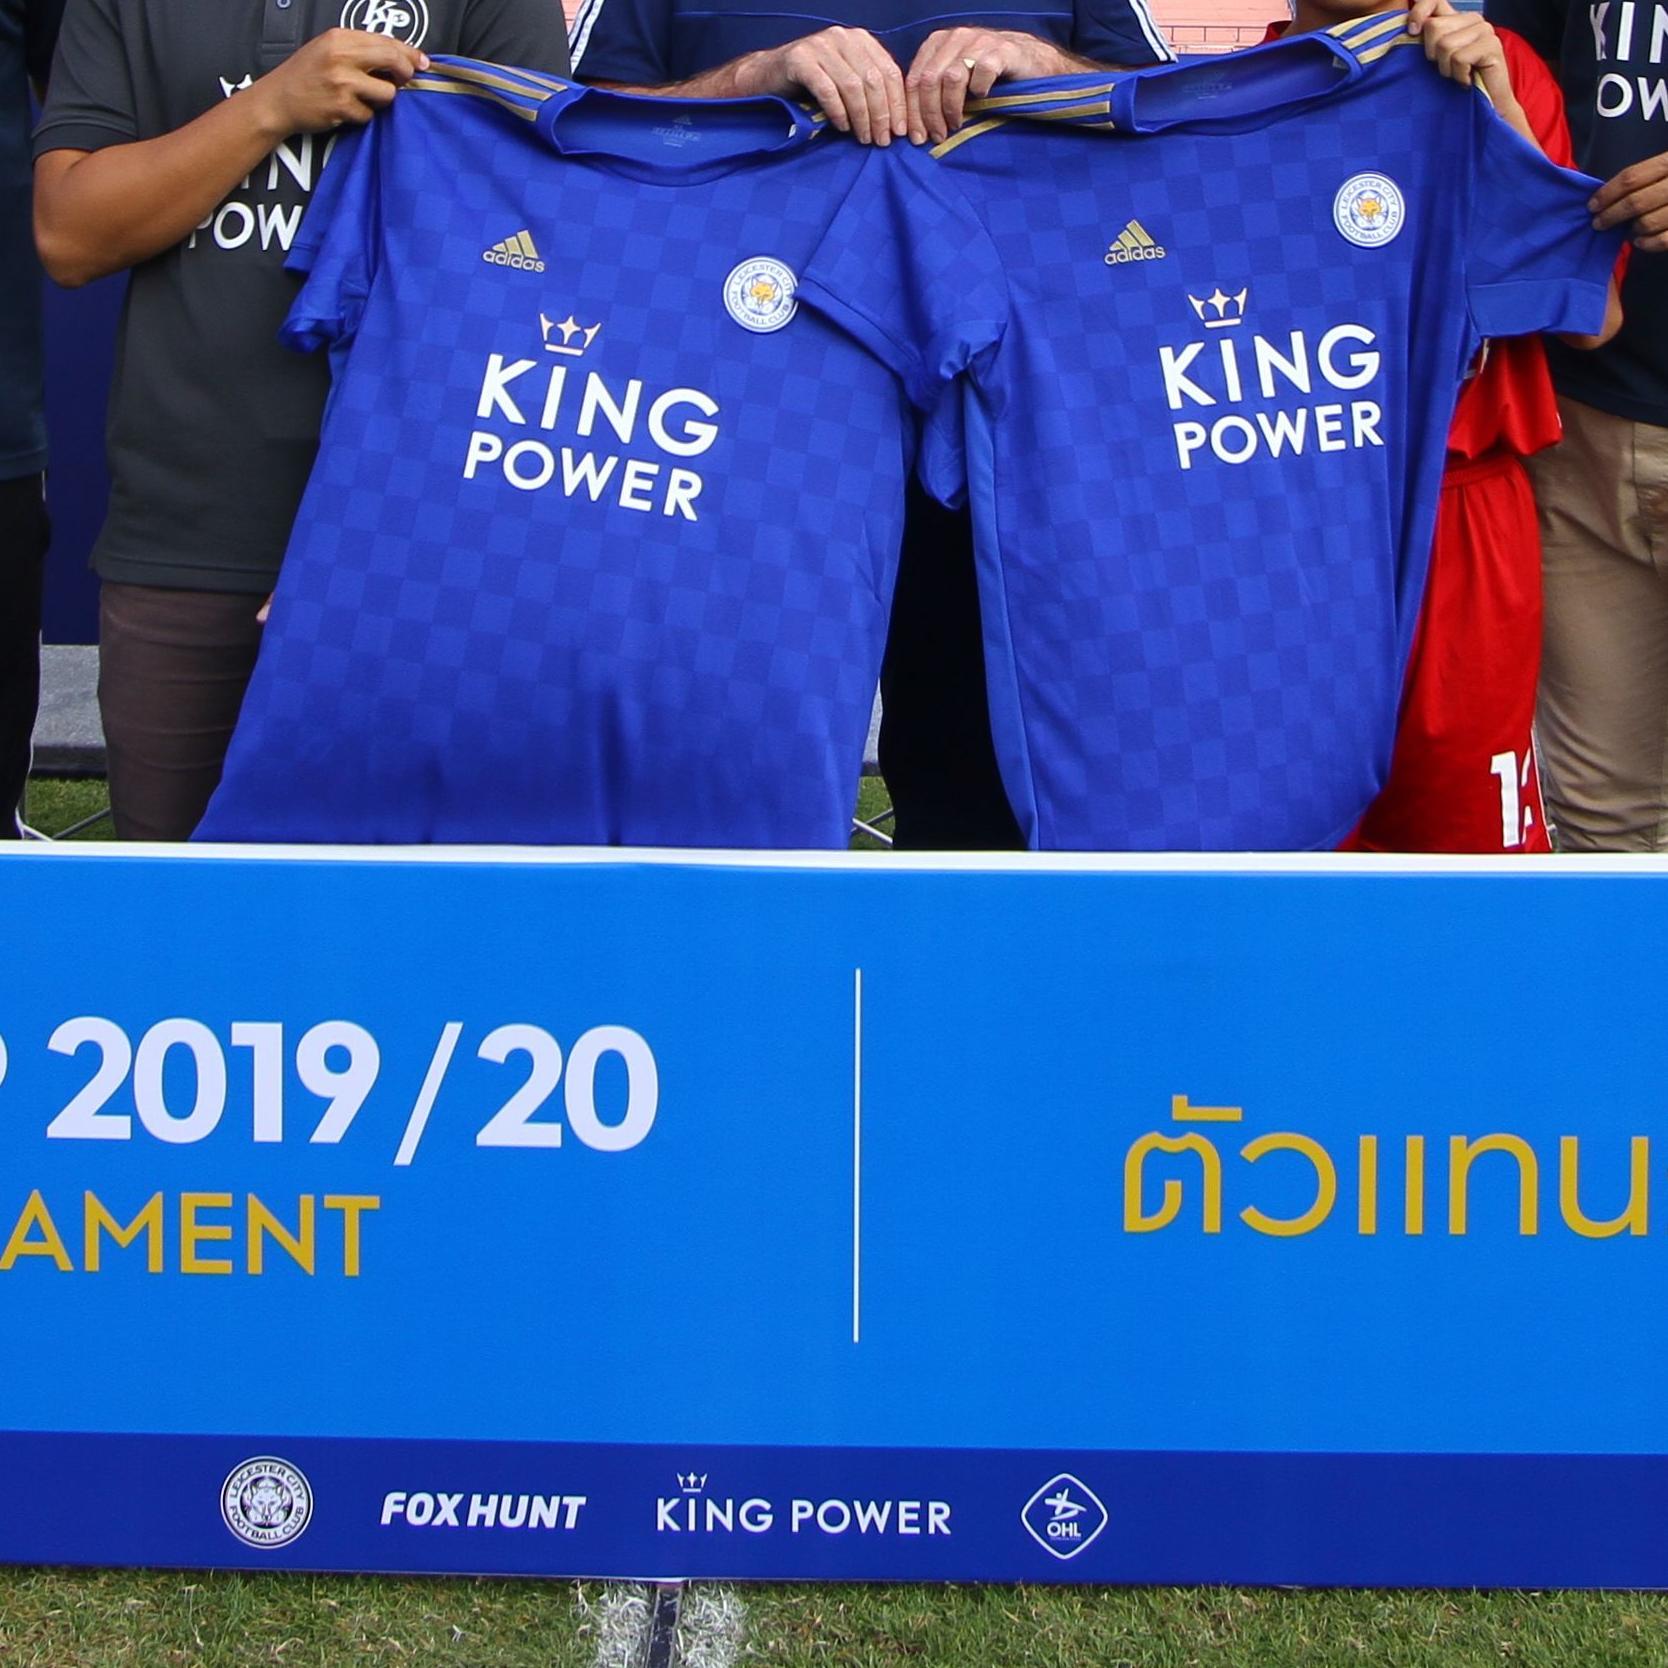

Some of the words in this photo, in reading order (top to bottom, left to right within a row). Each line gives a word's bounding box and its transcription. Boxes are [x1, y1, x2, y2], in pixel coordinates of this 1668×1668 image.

[481, 247, 546, 274] adidas
[1103, 245, 1166, 266] adidas
[1158, 323, 1381, 411] KING
[475, 352, 721, 458] KING
[1172, 400, 1385, 470] POWER
[462, 430, 704, 523] POWER
[46, 1016, 660, 1166] 2019/20
[230, 1463, 287, 1499] LEICESTER
[285, 1474, 305, 1500] CITY
[229, 1504, 283, 1541] FOOTBALL
[281, 1506, 304, 1535] CLUB
[380, 1492, 464, 1526] FOX
[466, 1494, 587, 1529] HUNT
[657, 1498, 773, 1533] KING
[792, 1500, 952, 1535] POWER
[1046, 1521, 1082, 1538] OHL
